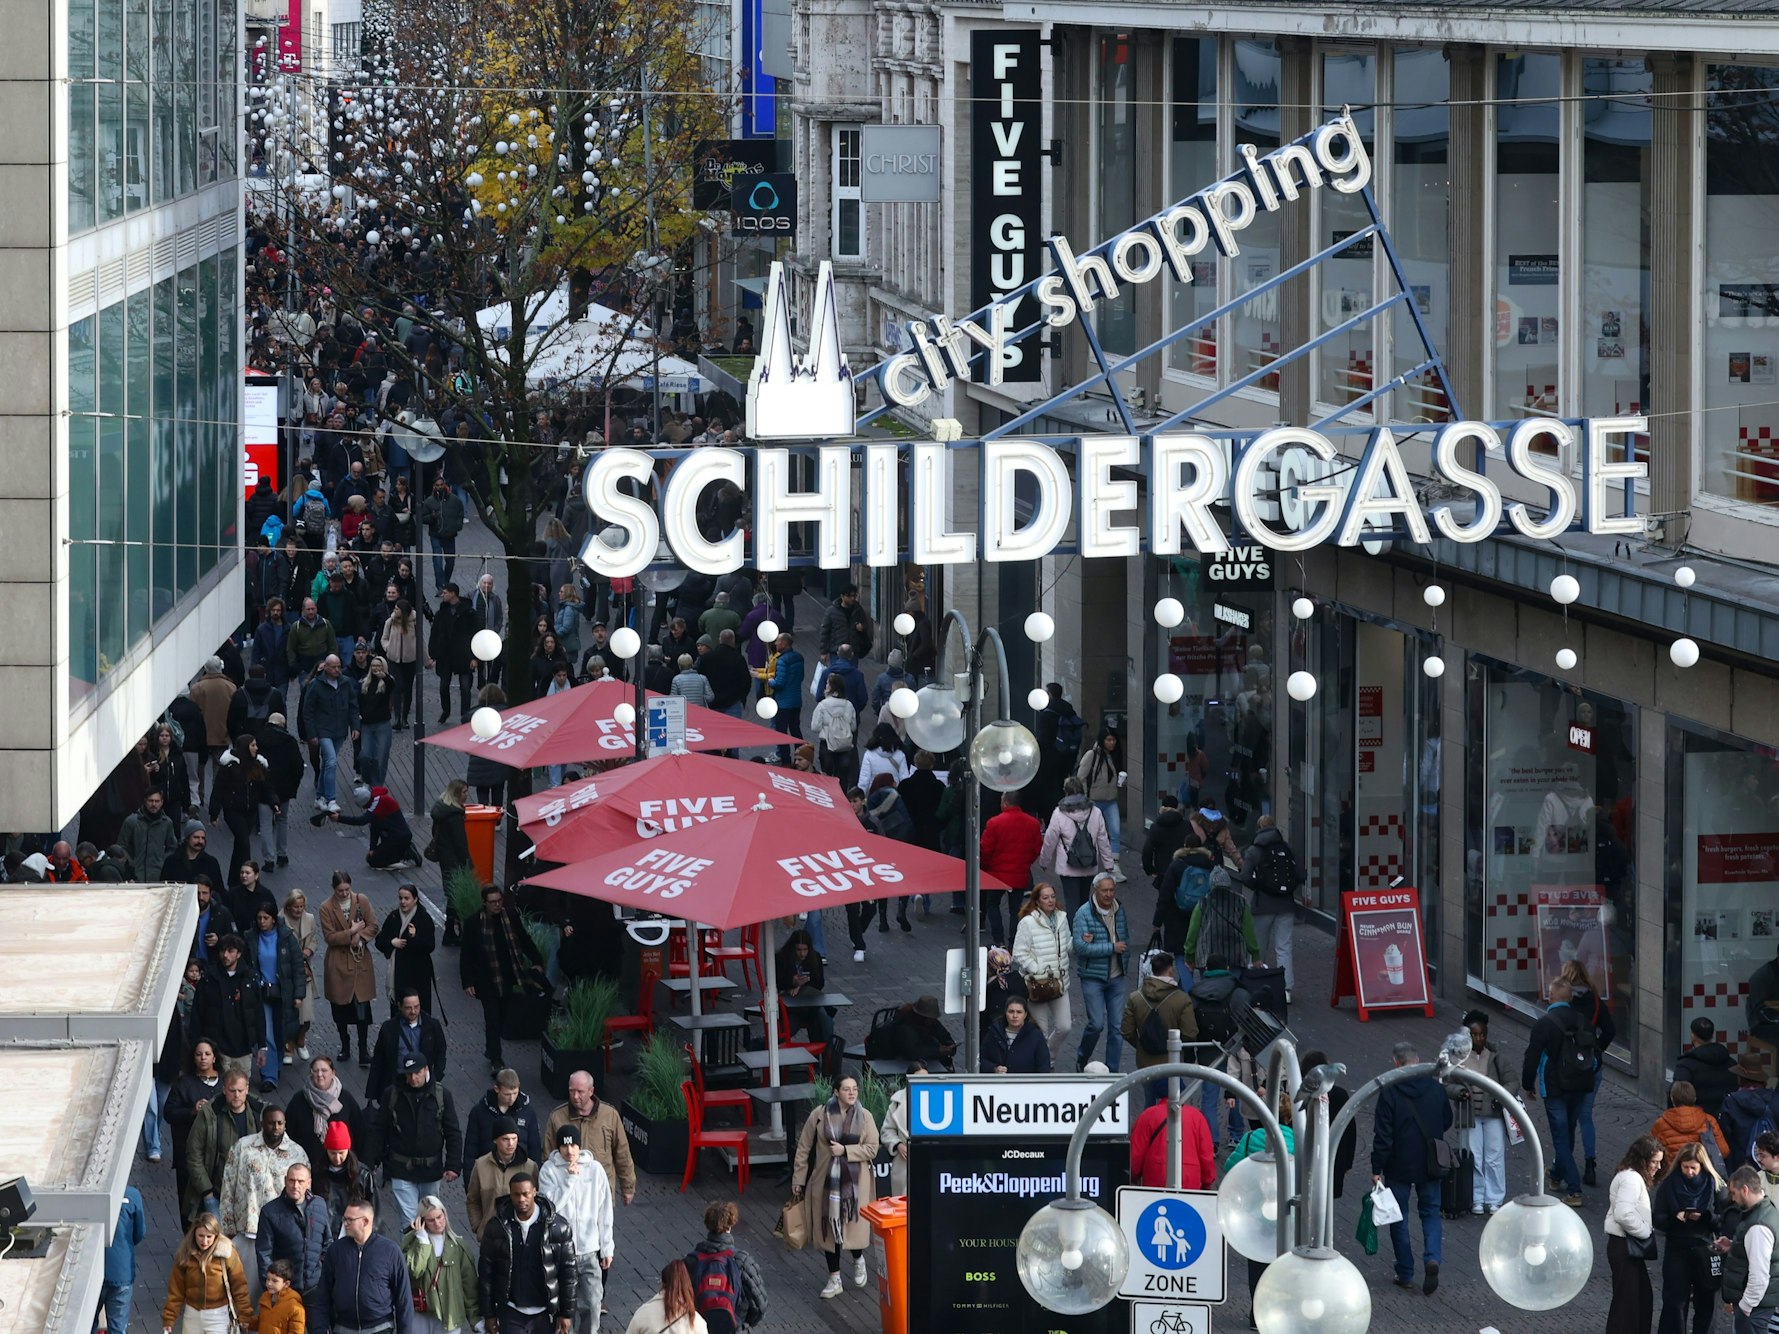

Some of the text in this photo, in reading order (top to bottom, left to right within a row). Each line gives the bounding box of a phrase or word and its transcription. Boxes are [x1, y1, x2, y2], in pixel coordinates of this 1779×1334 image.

[990, 44, 1025, 197] FIVE
[866, 153, 937, 175] CHRIST
[737, 216, 791, 231] IQOS
[1034, 115, 1373, 328] shopping
[580, 416, 1649, 579] SCHILDERGASSE
[1214, 545, 1264, 562] FIVE
[1208, 562, 1271, 581] GUYS
[1569, 726, 1591, 749] OPEN
[639, 796, 738, 818] FIVE
[634, 848, 715, 878] FIVE
[776, 846, 876, 877] FIVE
[603, 866, 692, 899] GUYS
[790, 863, 905, 898] GUYS
[1352, 894, 1411, 906] FIVE GUYS
[1396, 921, 1413, 930] BUN
[919, 1090, 954, 1131] U
[1001, 1150, 1045, 1159] JCDecaux
[959, 1238, 987, 1248] YOUR
[965, 1271, 997, 1282] BOSS
[1144, 1273, 1198, 1293] ZONE
